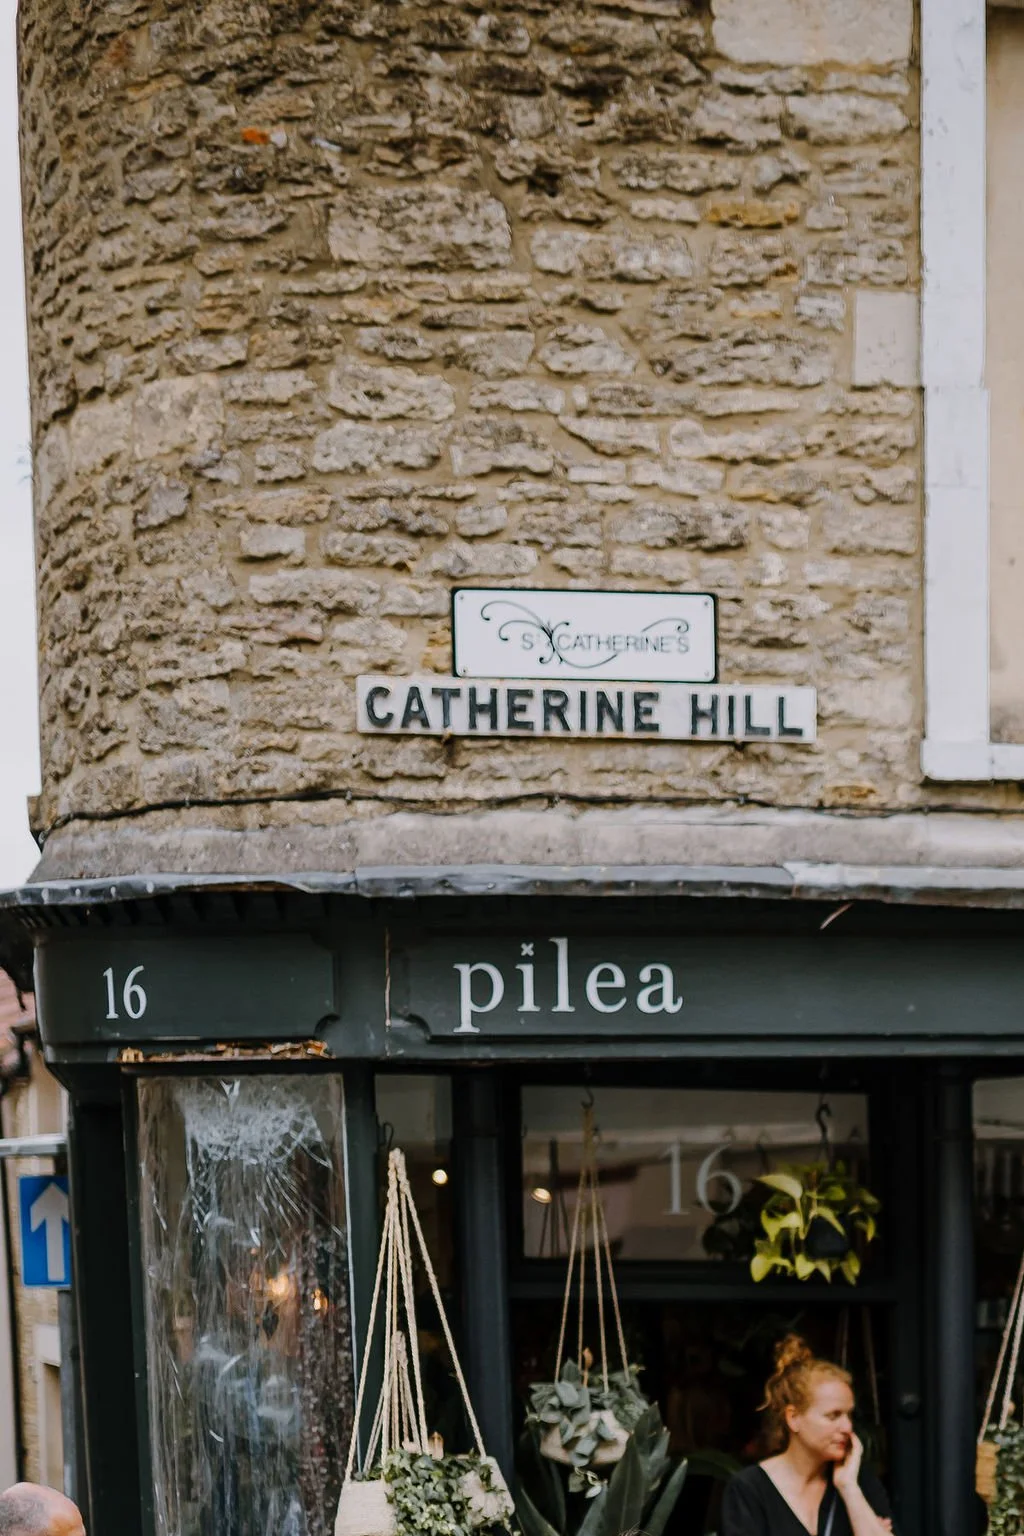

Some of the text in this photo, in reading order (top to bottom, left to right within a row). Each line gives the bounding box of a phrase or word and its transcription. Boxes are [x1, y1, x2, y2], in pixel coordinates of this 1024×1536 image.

[365, 686, 804, 737] CATHERINE HILL
[103, 964, 148, 1021] 16
[452, 936, 685, 1034] pilea
[660, 1143, 743, 1216] 16
